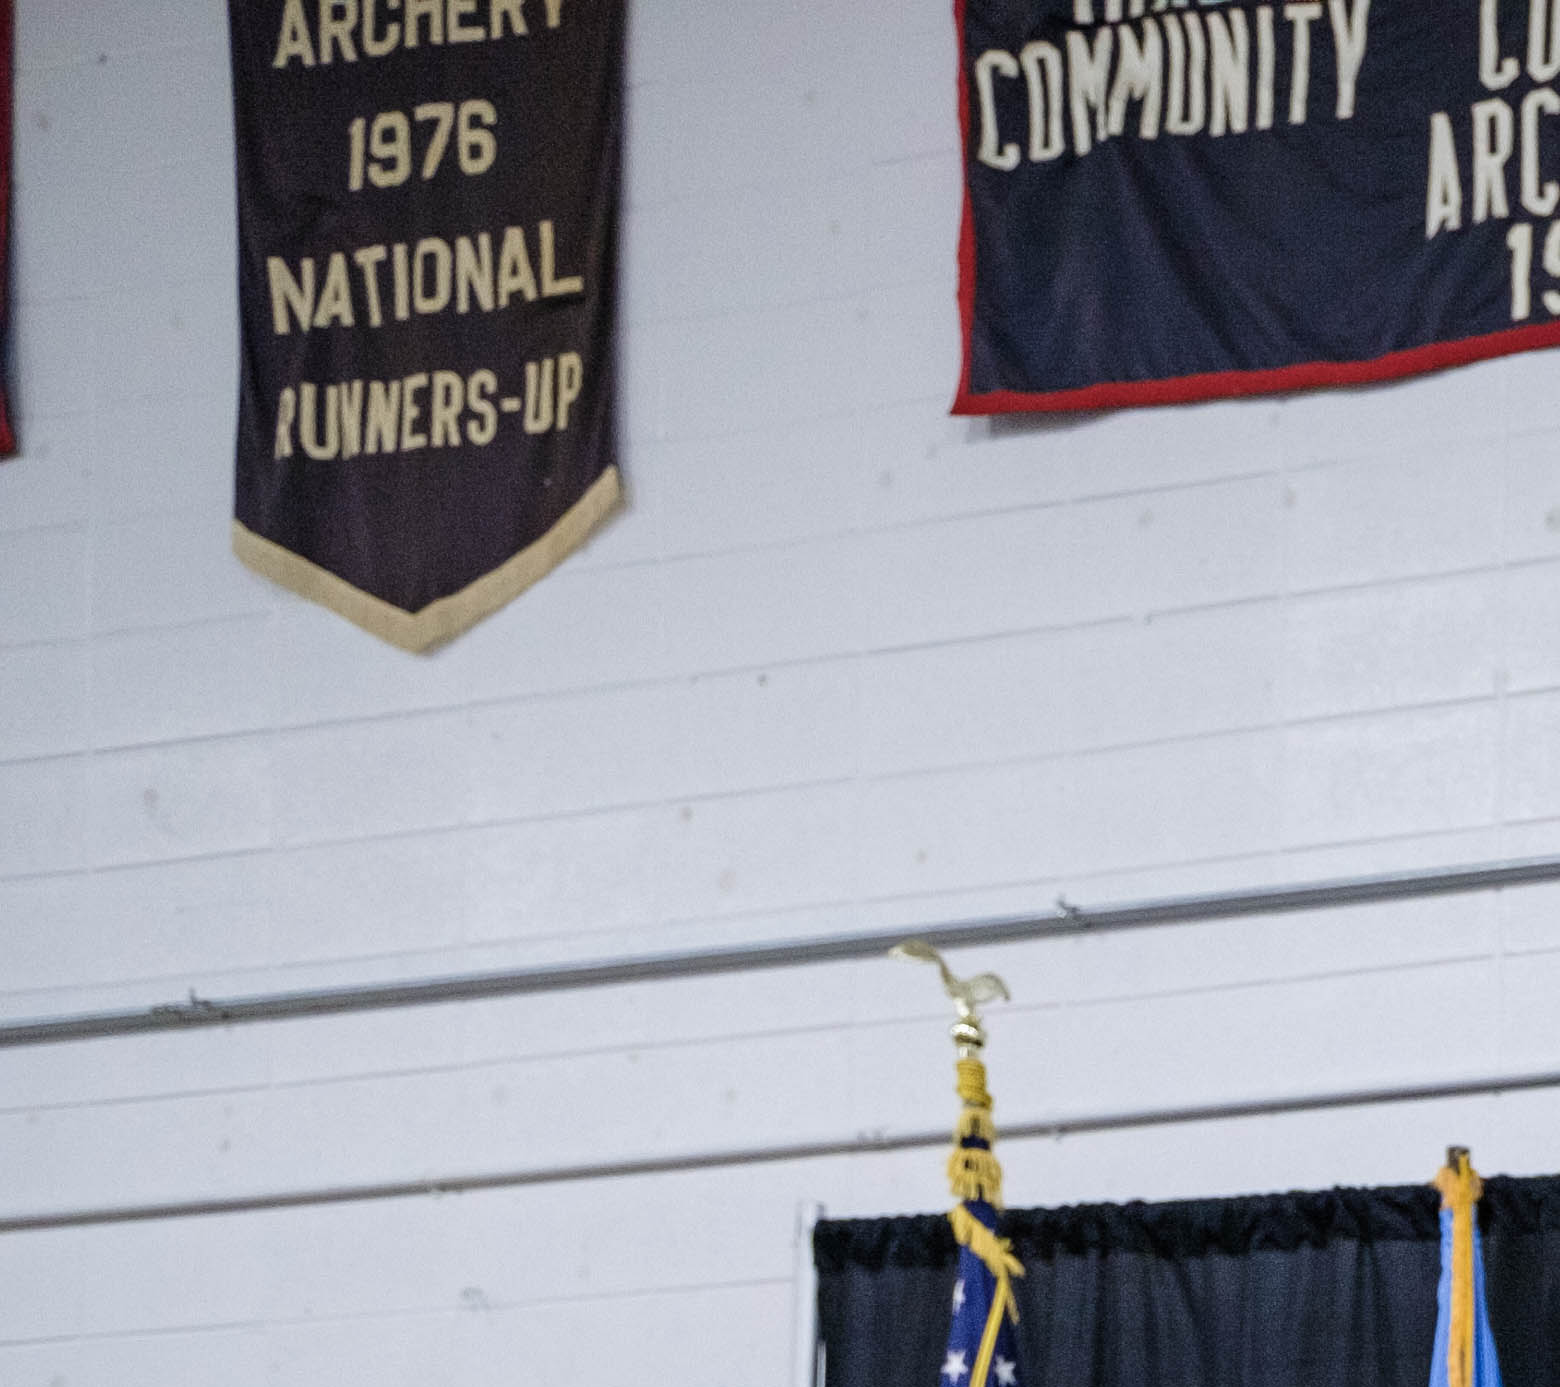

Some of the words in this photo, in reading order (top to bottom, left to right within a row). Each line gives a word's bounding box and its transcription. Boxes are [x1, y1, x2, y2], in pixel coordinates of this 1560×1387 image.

[974, 0, 1369, 171] COMMUNITY
[349, 100, 497, 192] 1976
[266, 220, 584, 335] NATIONAL
